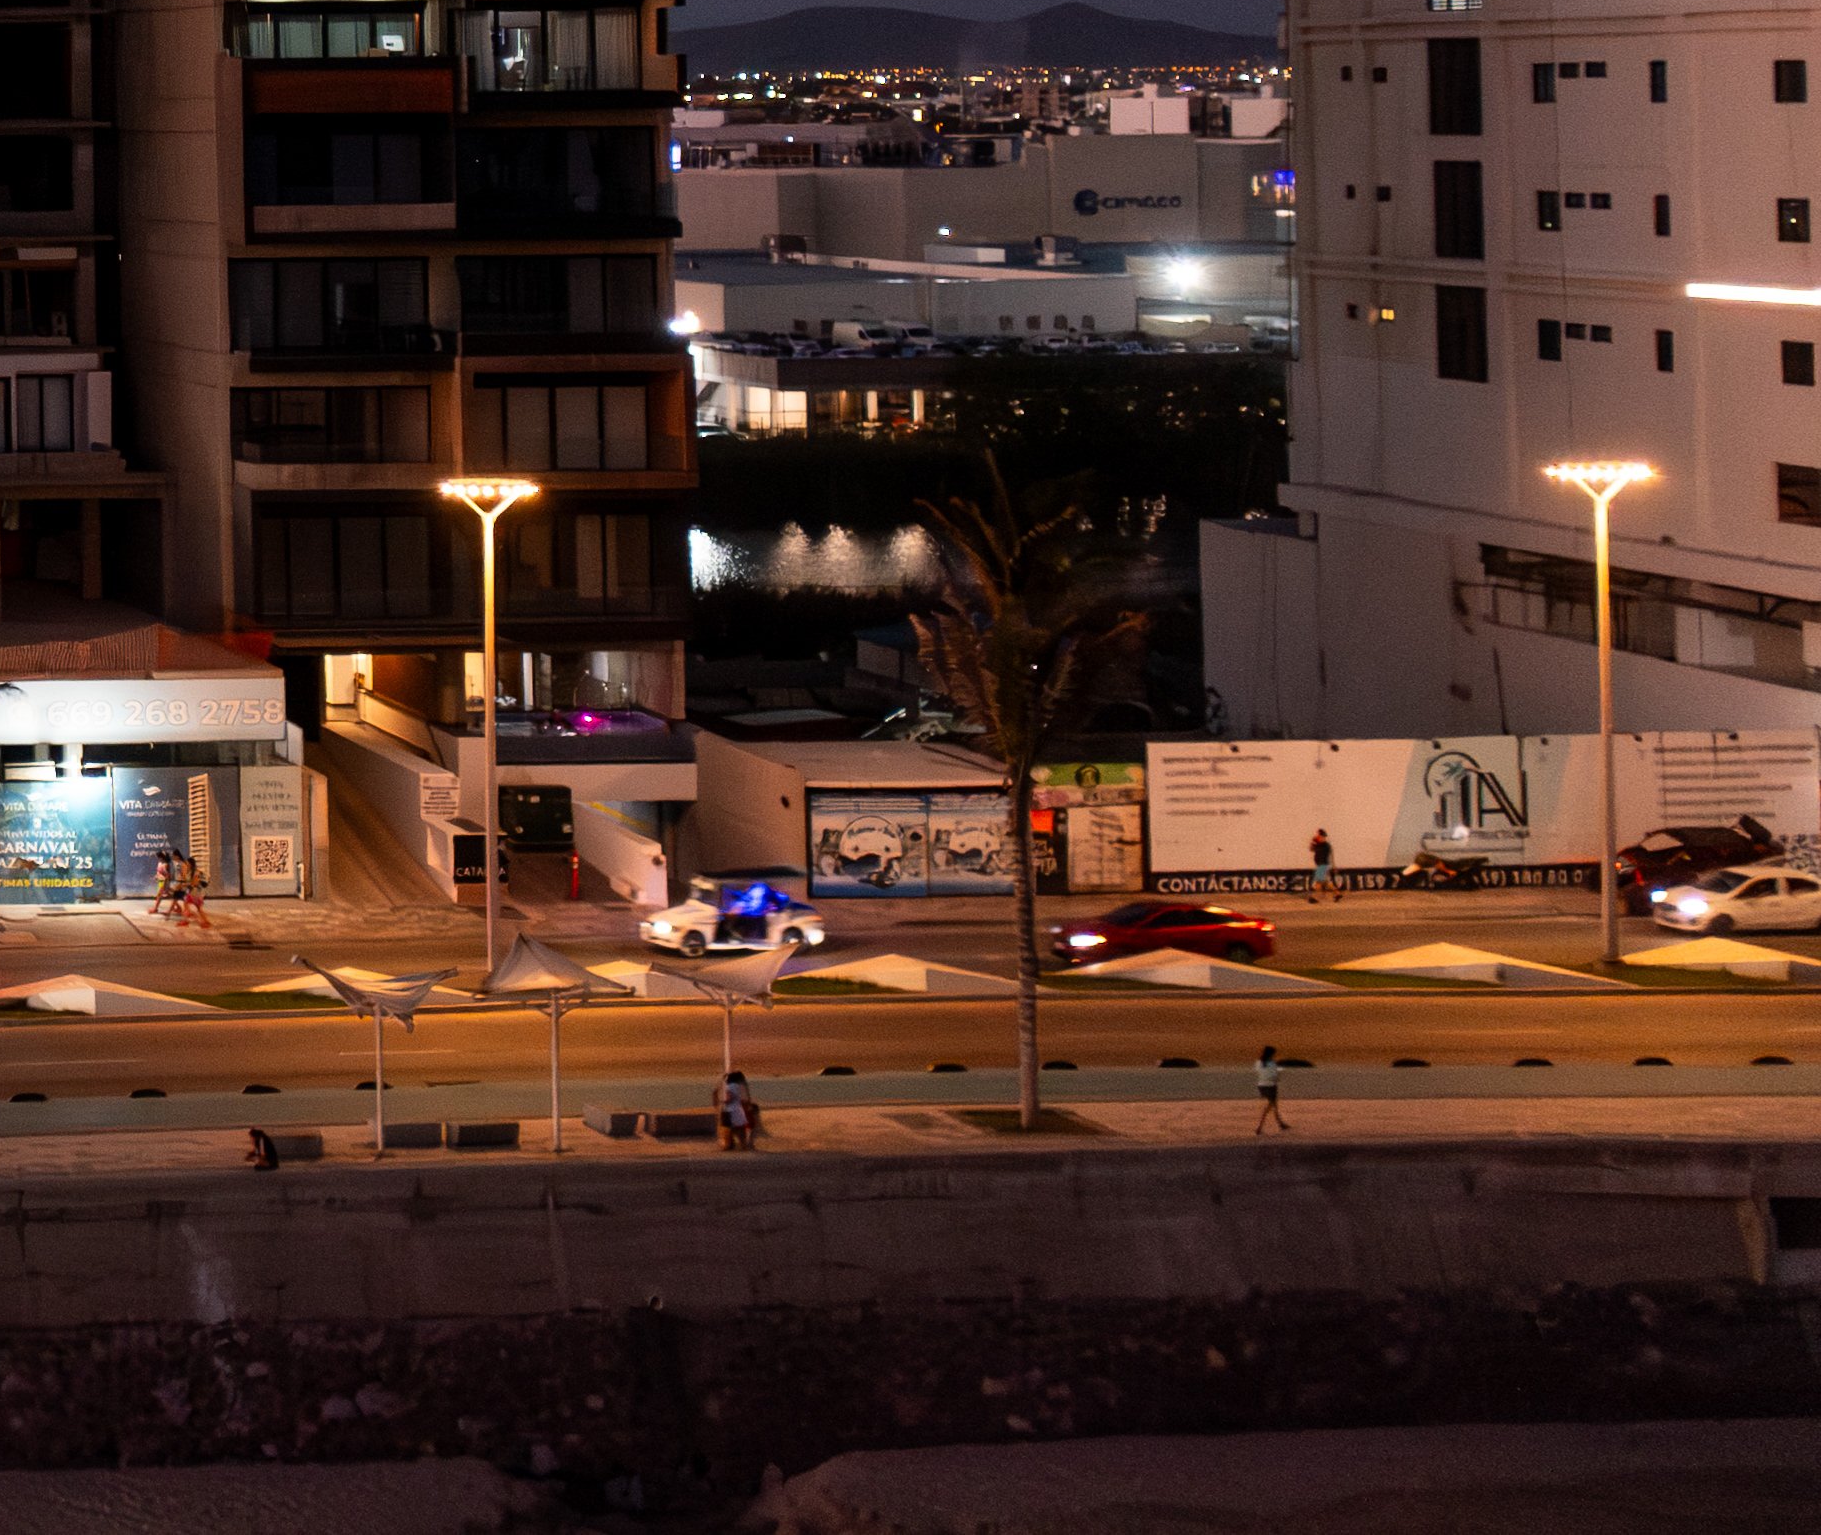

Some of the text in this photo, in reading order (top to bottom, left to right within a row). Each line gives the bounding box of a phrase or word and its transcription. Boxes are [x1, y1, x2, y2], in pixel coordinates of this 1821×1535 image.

[47, 699, 285, 726] 669 268 2758
[119, 800, 142, 810] VITA
[33, 877, 94, 887] UNIDADES
[1157, 874, 1287, 893] CONTÁCTANOS
